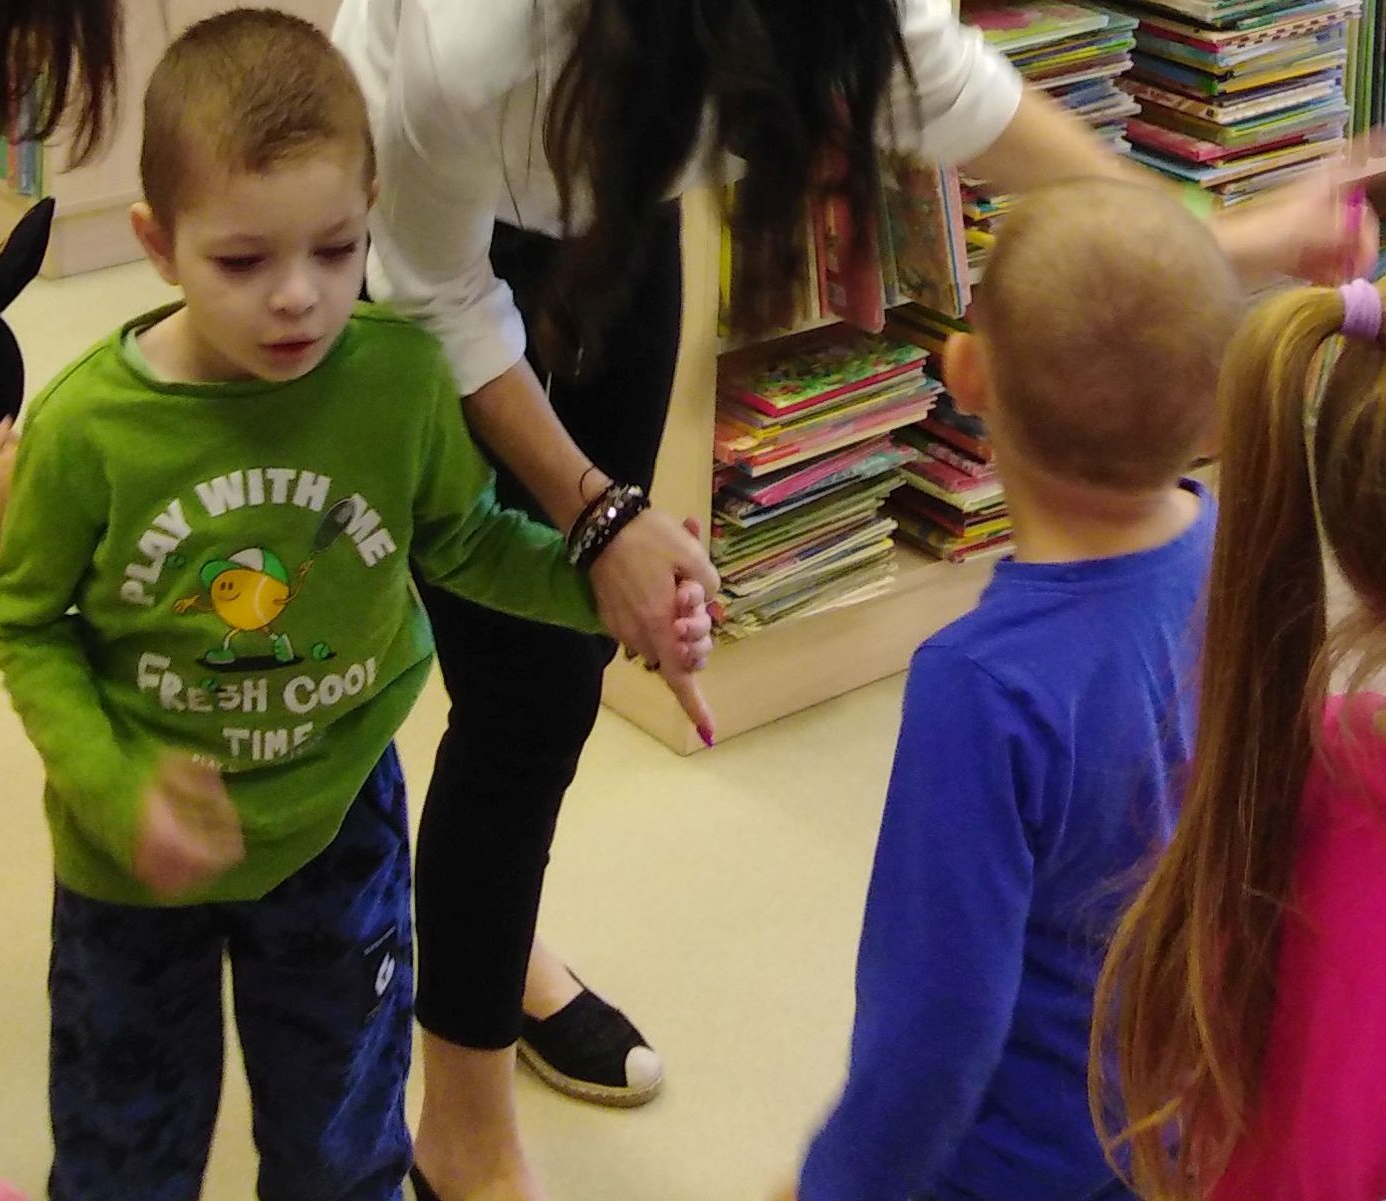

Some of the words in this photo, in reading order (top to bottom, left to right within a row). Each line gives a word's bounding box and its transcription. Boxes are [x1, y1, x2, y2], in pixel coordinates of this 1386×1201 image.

[120, 498, 193, 607] PLAY
[194, 467, 333, 518] WITH
[343, 493, 398, 568] ME
